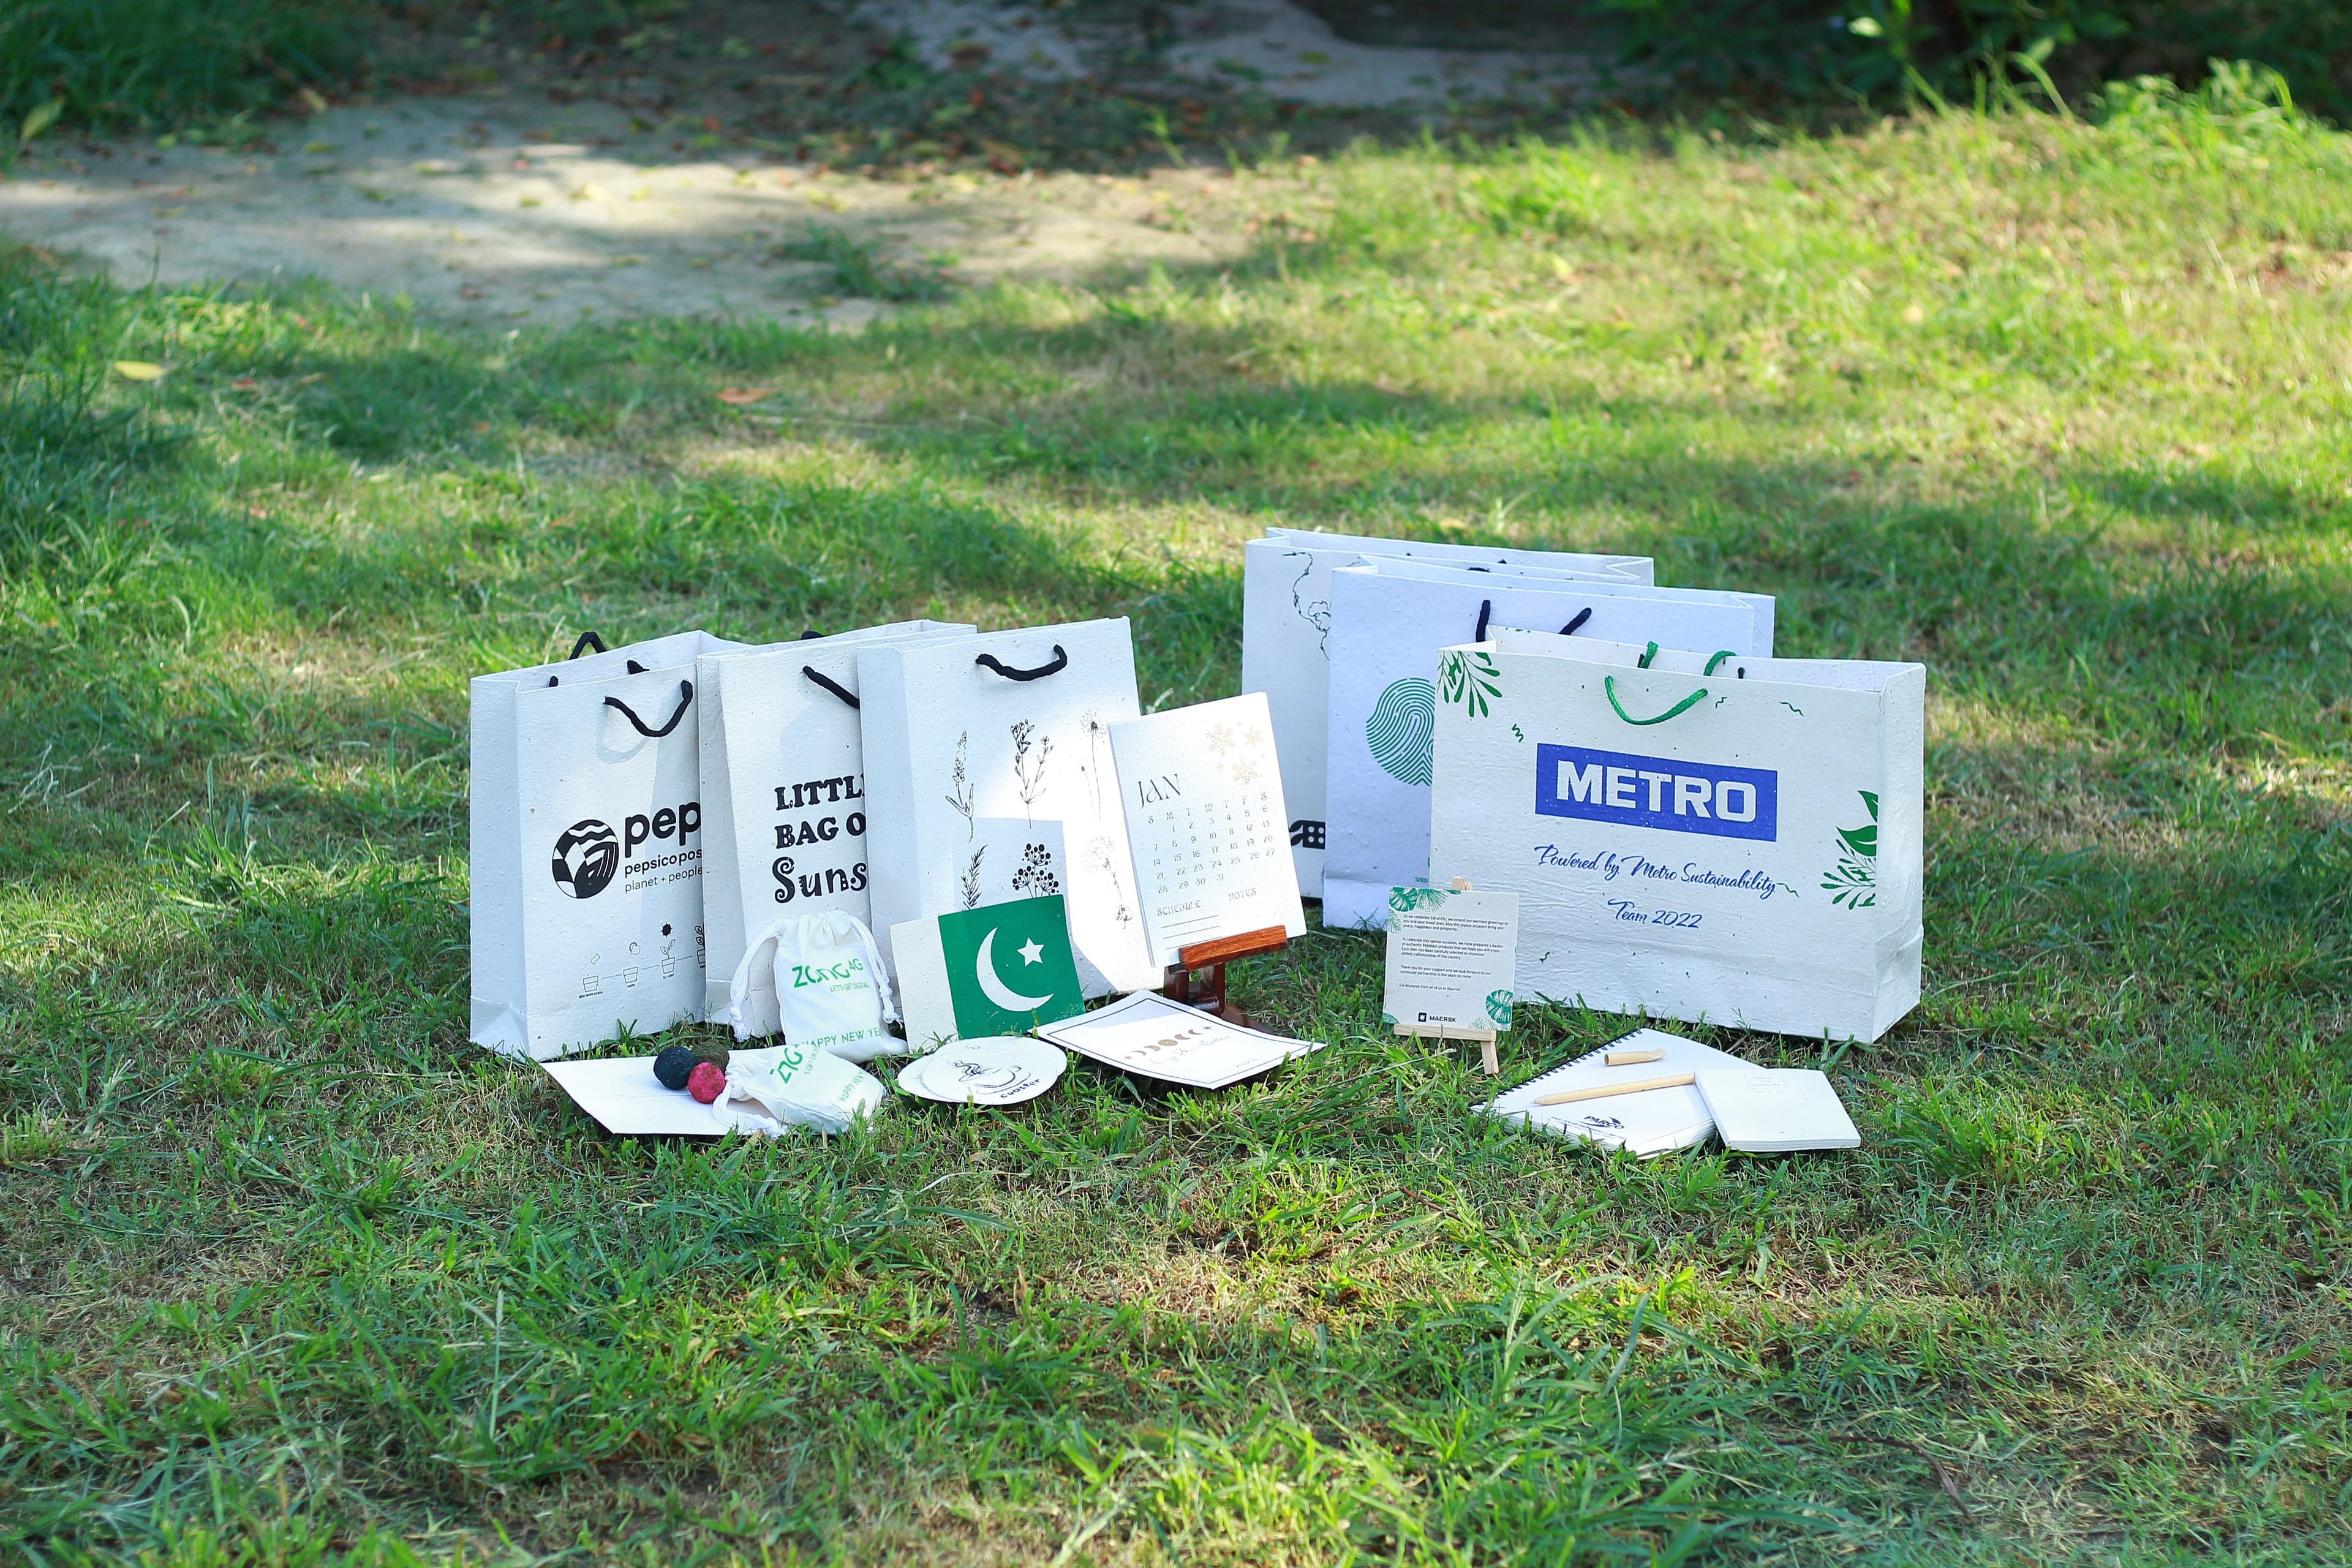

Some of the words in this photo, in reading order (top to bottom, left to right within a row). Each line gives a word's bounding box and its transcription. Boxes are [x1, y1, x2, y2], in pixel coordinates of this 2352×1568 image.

[774, 774, 865, 810] LITTL
[1137, 774, 1181, 809] JAN
[1556, 760, 1757, 823] METRO
[1148, 816, 1154, 824] S
[1166, 812, 1174, 821] M
[1185, 808, 1191, 816] T
[1205, 803, 1213, 812] W
[1223, 800, 1229, 809] T
[1242, 796, 1247, 805] F
[1261, 792, 1267, 801] S
[625, 802, 701, 858] pep
[774, 817, 839, 849] BAG
[1190, 835, 1196, 844] 9
[625, 854, 677, 878] pepsico
[1153, 858, 1161, 867] 14
[1174, 853, 1182, 862] 15
[1192, 850, 1201, 858] 16
[1212, 845, 1219, 854] 17
[1246, 838, 1255, 847] 19
[1263, 834, 1273, 843] 20
[1156, 872, 1164, 880] 21
[1176, 867, 1186, 876] 22
[1193, 863, 1204, 872] 23
[1212, 859, 1222, 869] 24
[1231, 856, 1241, 865] 25
[1250, 851, 1260, 860] 26
[1265, 848, 1275, 857] 27
[625, 876, 658, 894] planet
[669, 865, 703, 884] people
[772, 856, 867, 903] Suns
[1158, 884, 1168, 894] 28
[1178, 881, 1189, 889] 29
[1195, 877, 1206, 886] 30
[1216, 873, 1224, 882] 31
[1534, 844, 1609, 870] Powered
[1604, 853, 1619, 881] by
[1621, 856, 1678, 878] Metro
[1680, 862, 1776, 900] Sustainability
[1157, 900, 1201, 917] SCHEDULE
[1228, 888, 1257, 901] NOTES
[1607, 899, 1648, 924] Team
[1651, 910, 1703, 929] 2022
[848, 959, 864, 971] 4G
[803, 1035, 837, 1048] APPY
[842, 1030, 864, 1043] NEW
[867, 1027, 881, 1038] YE
[1583, 1116, 1625, 1129] PARCO
